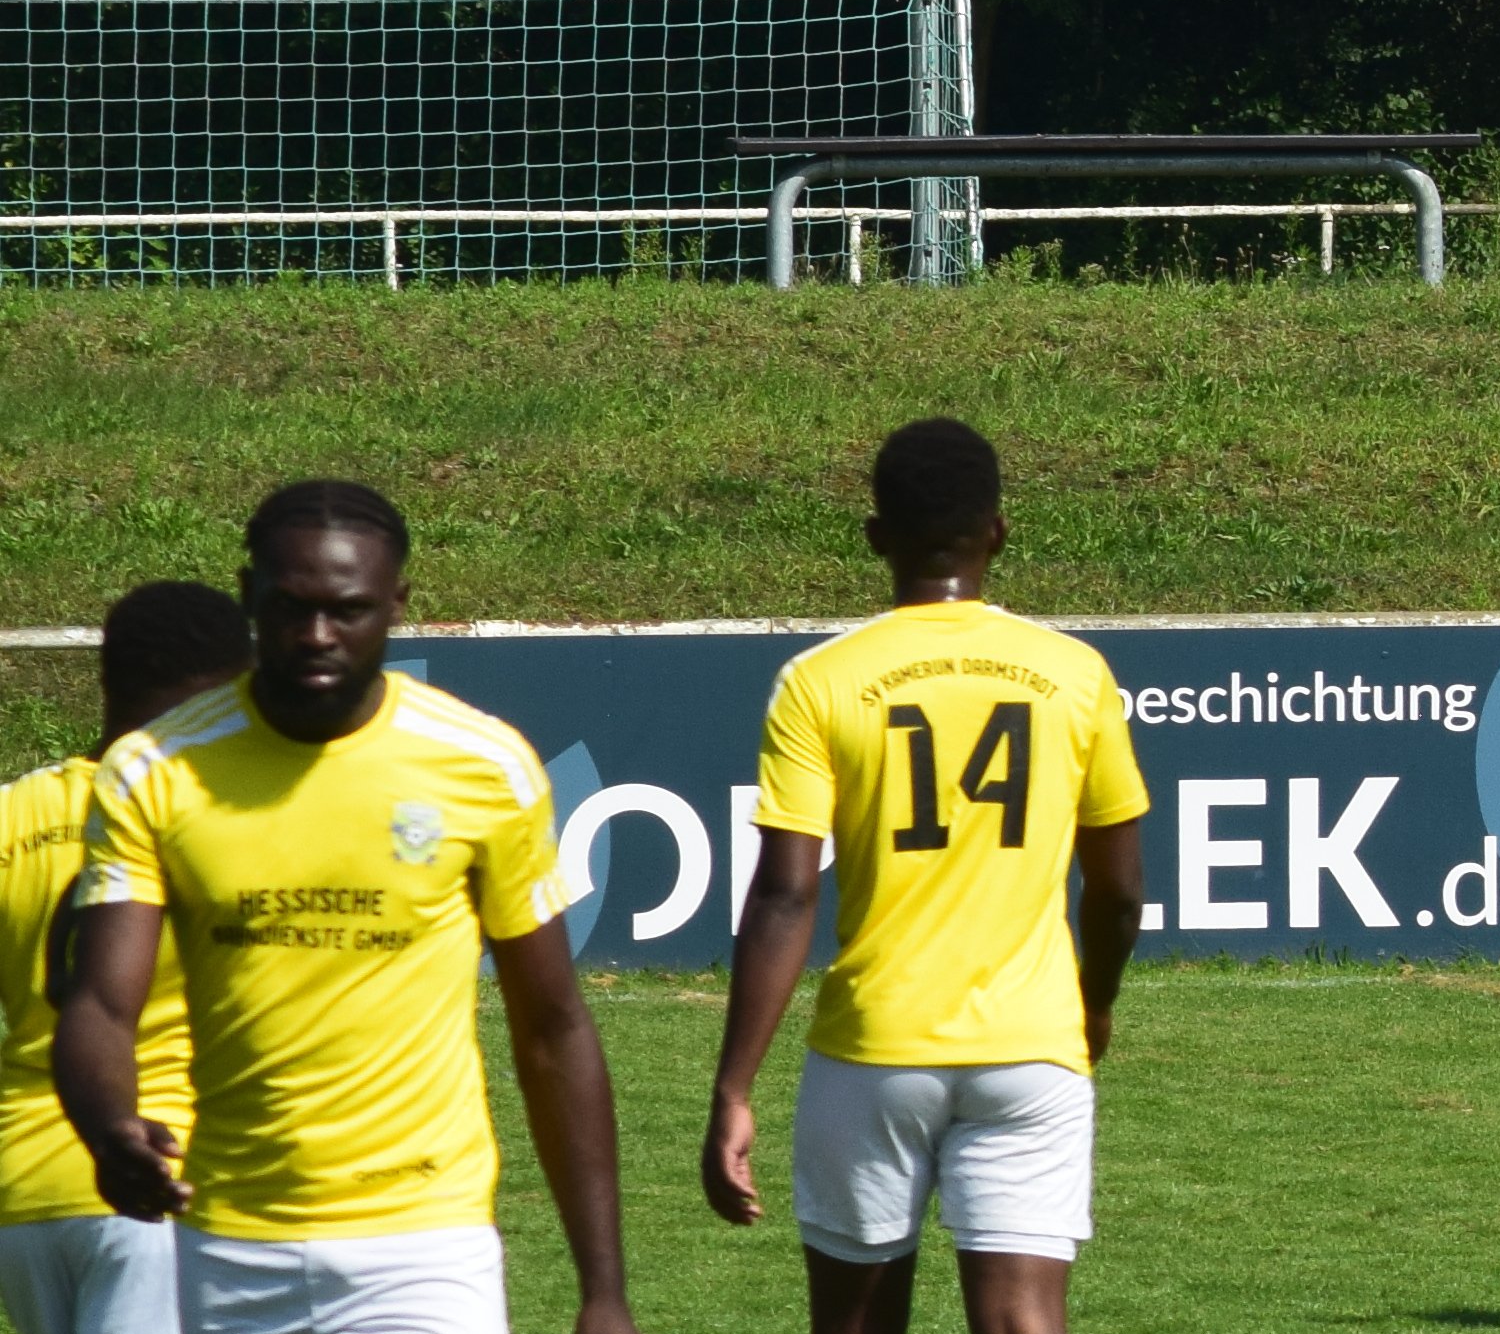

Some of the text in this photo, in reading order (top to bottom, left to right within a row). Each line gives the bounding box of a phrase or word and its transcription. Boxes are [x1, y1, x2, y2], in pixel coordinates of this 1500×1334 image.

[861, 658, 1059, 707] SV KAMERUN DARMSTADT
[888, 701, 1032, 852] 14
[238, 888, 384, 916] HESSISCHE
